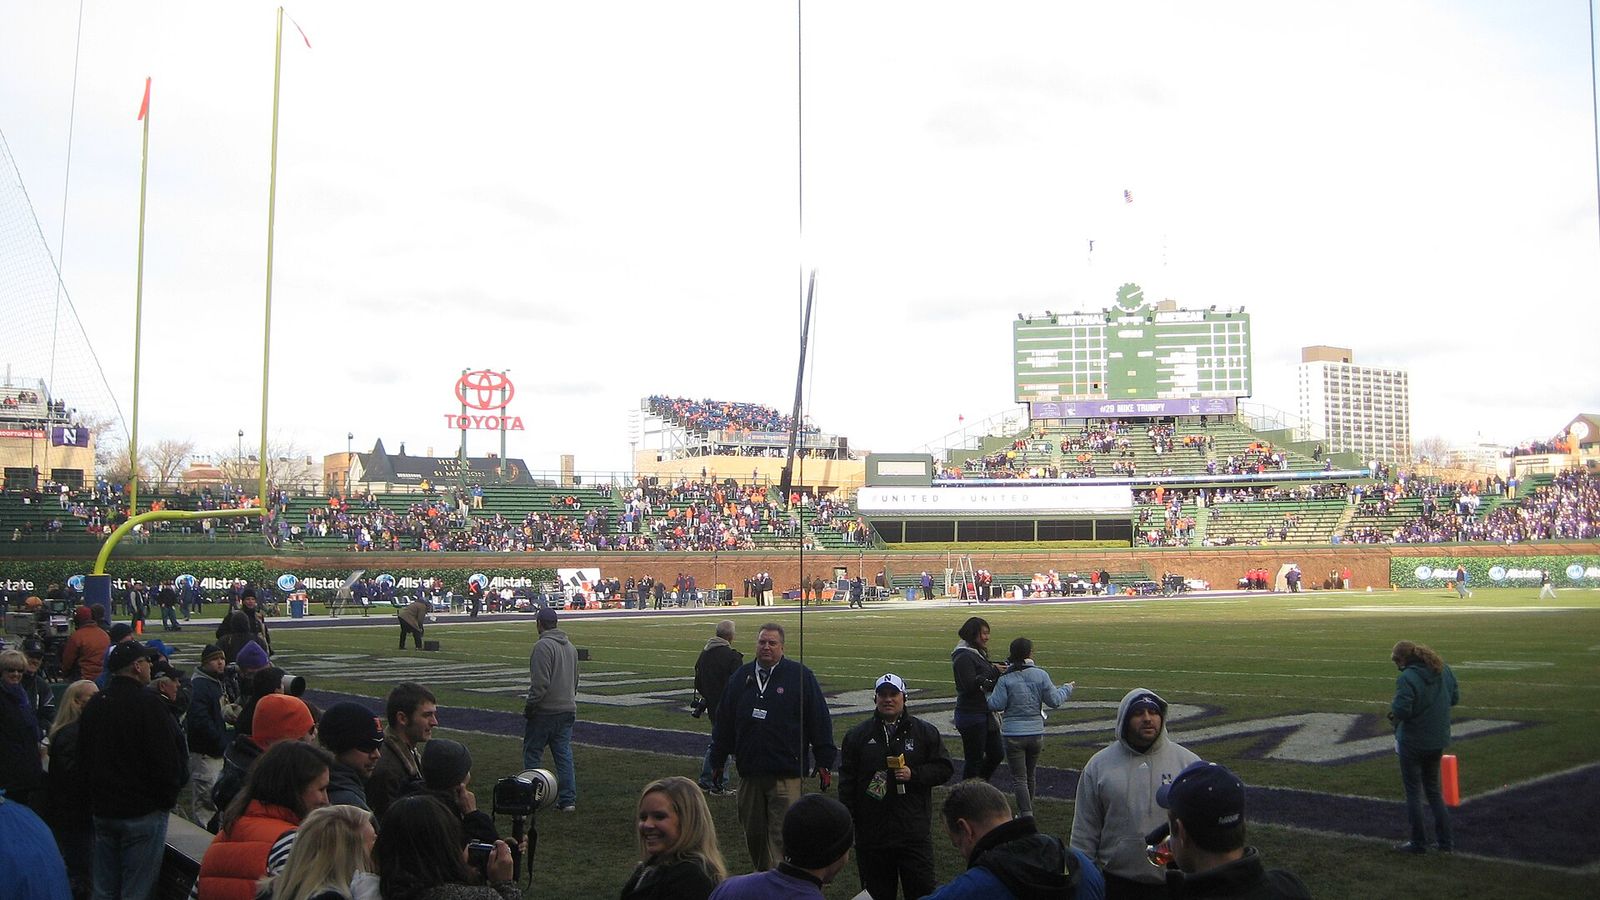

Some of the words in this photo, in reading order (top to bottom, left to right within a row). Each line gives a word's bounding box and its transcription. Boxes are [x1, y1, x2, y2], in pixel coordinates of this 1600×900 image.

[1117, 403, 1135, 413] MIKE
[1136, 402, 1166, 412] TRUMPY
[443, 414, 525, 431] TOYOTA
[63, 428, 77, 445] N
[881, 494, 939, 503] UNITED
[970, 494, 1029, 503] UNITED
[302, 577, 346, 590] Allstate
[488, 576, 532, 588] Allstate
[884, 674, 892, 682] N
